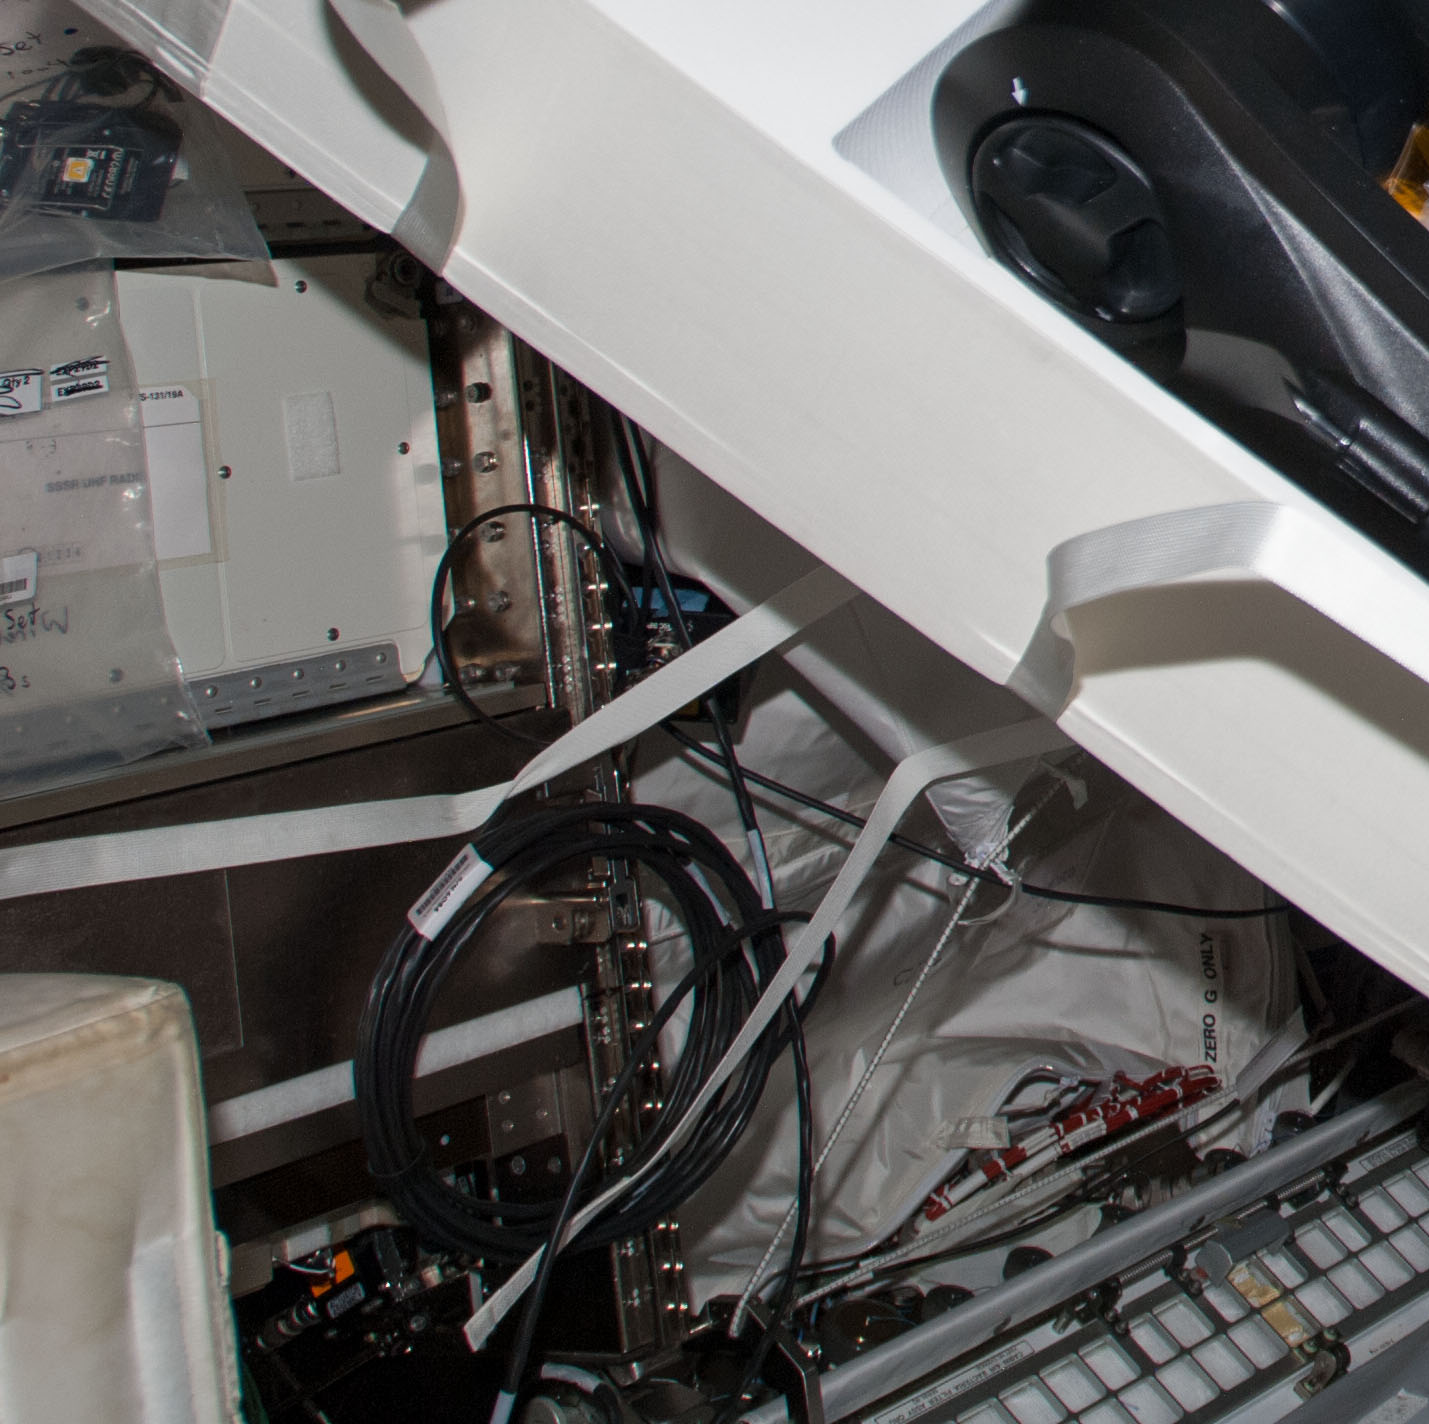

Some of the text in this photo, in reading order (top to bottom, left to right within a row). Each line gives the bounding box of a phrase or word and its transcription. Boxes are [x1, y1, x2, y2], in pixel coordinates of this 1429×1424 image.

[23, 375, 31, 385] 2
[1200, 933, 1219, 1064] ZERO G ONLY
